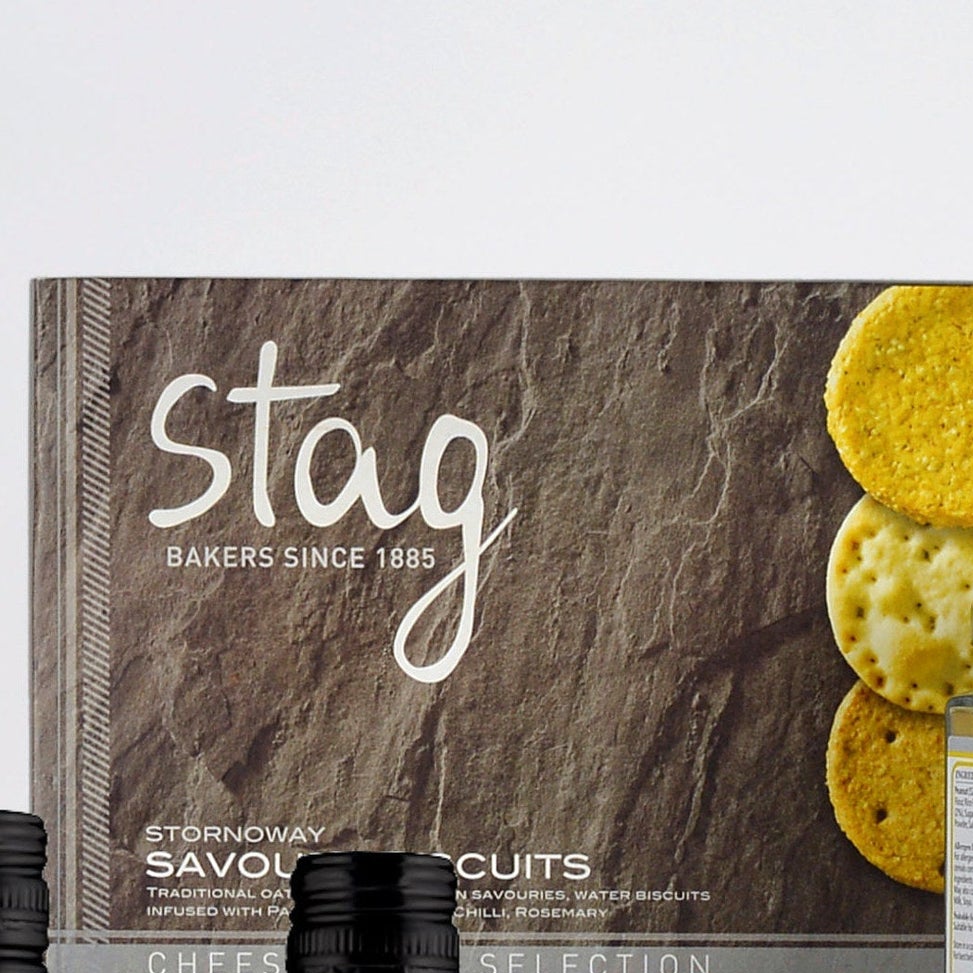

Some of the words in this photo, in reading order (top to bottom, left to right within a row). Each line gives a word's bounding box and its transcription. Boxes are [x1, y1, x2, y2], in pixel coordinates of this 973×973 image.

[166, 546, 274, 568] BAKERS
[284, 547, 365, 569] SINCE
[376, 547, 435, 569] 1885
[146, 825, 326, 843] STORNOWAY
[146, 851, 297, 879] SAVOU
[433, 852, 591, 880] CUITS
[147, 886, 253, 899] TRADITIONAL
[472, 889, 570, 902] SAVOURIES,
[575, 890, 632, 901] WATER
[636, 890, 711, 901] BISCUITS
[147, 906, 218, 917] INFUSED
[223, 906, 262, 917] WITH
[454, 906, 510, 919] CHILLI,
[515, 907, 609, 919] ROSEMARY
